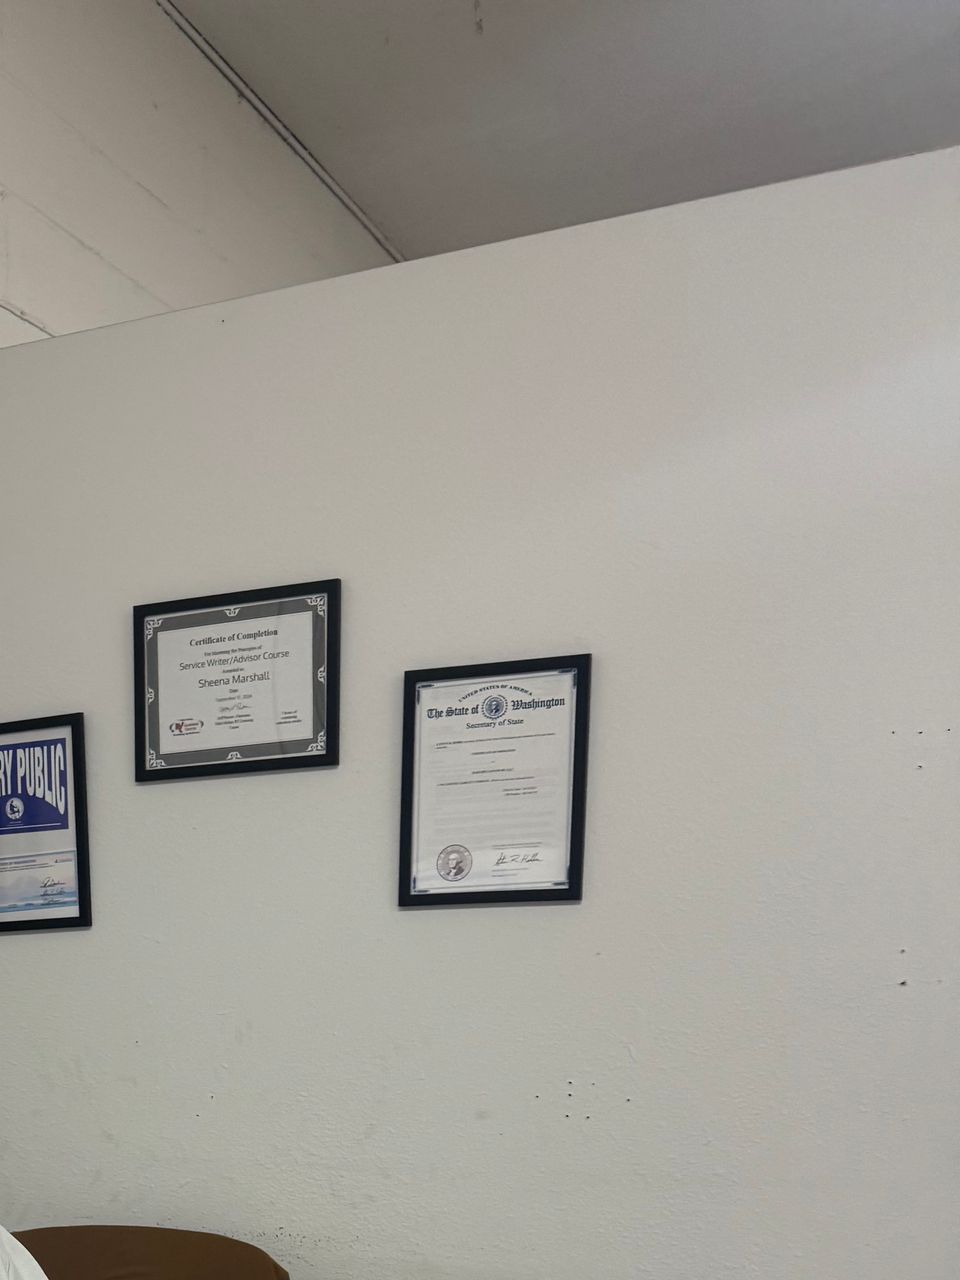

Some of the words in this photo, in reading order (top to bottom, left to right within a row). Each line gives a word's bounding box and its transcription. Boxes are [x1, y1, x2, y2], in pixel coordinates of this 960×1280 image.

[189, 636, 227, 647] Certificate
[227, 633, 235, 642] of
[236, 629, 278, 641] Completion
[179, 661, 206, 671] Service
[206, 653, 261, 667] Writer/Advisor
[262, 650, 290, 660] Course
[198, 677, 230, 689] Sheena
[231, 671, 270, 684] Marshall
[479, 685, 499, 693] STATES
[509, 685, 533, 697] AMERICA
[427, 708, 443, 719] The
[445, 707, 469, 717] State
[471, 704, 479, 715] of
[511, 698, 566, 711] Washington
[507, 718, 525, 726] State
[16, 743, 66, 816] PUBLIC
